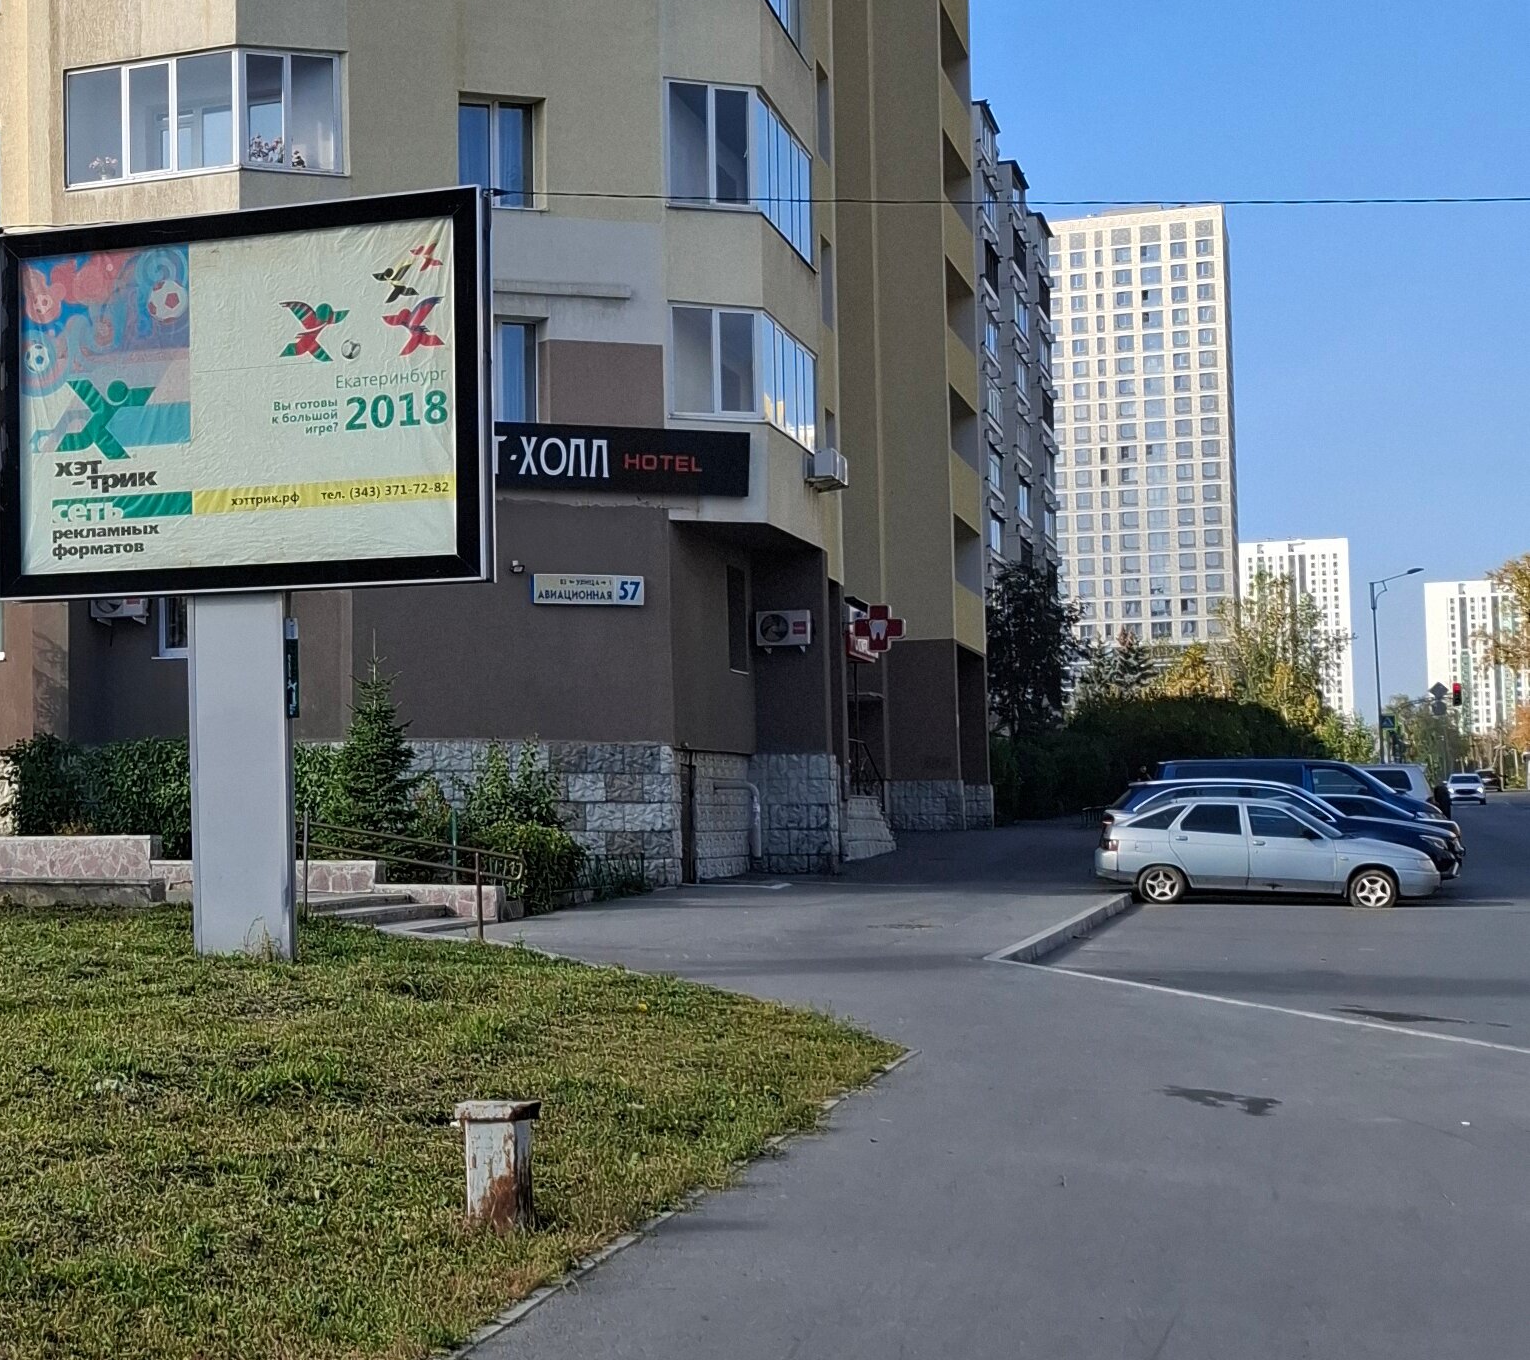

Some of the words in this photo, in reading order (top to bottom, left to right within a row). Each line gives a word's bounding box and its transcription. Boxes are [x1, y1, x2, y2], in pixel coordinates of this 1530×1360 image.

[335, 368, 447, 389] Екатеринбург
[273, 401, 292, 412] Вы
[295, 399, 338, 411] готовы
[344, 390, 448, 431] 2018
[271, 416, 279, 424] к
[282, 410, 338, 423] большой
[305, 422, 339, 436] игре?
[624, 453, 703, 472] HOTEL
[321, 490, 345, 500] тел.
[350, 486, 381, 500] (343)
[385, 481, 449, 496] 371-72-82
[52, 502, 124, 523] сеть
[52, 524, 160, 543] рекламных
[52, 542, 145, 560] форматов
[537, 590, 613, 601] АВИАЦИОННАЯ
[619, 581, 641, 600] 57
